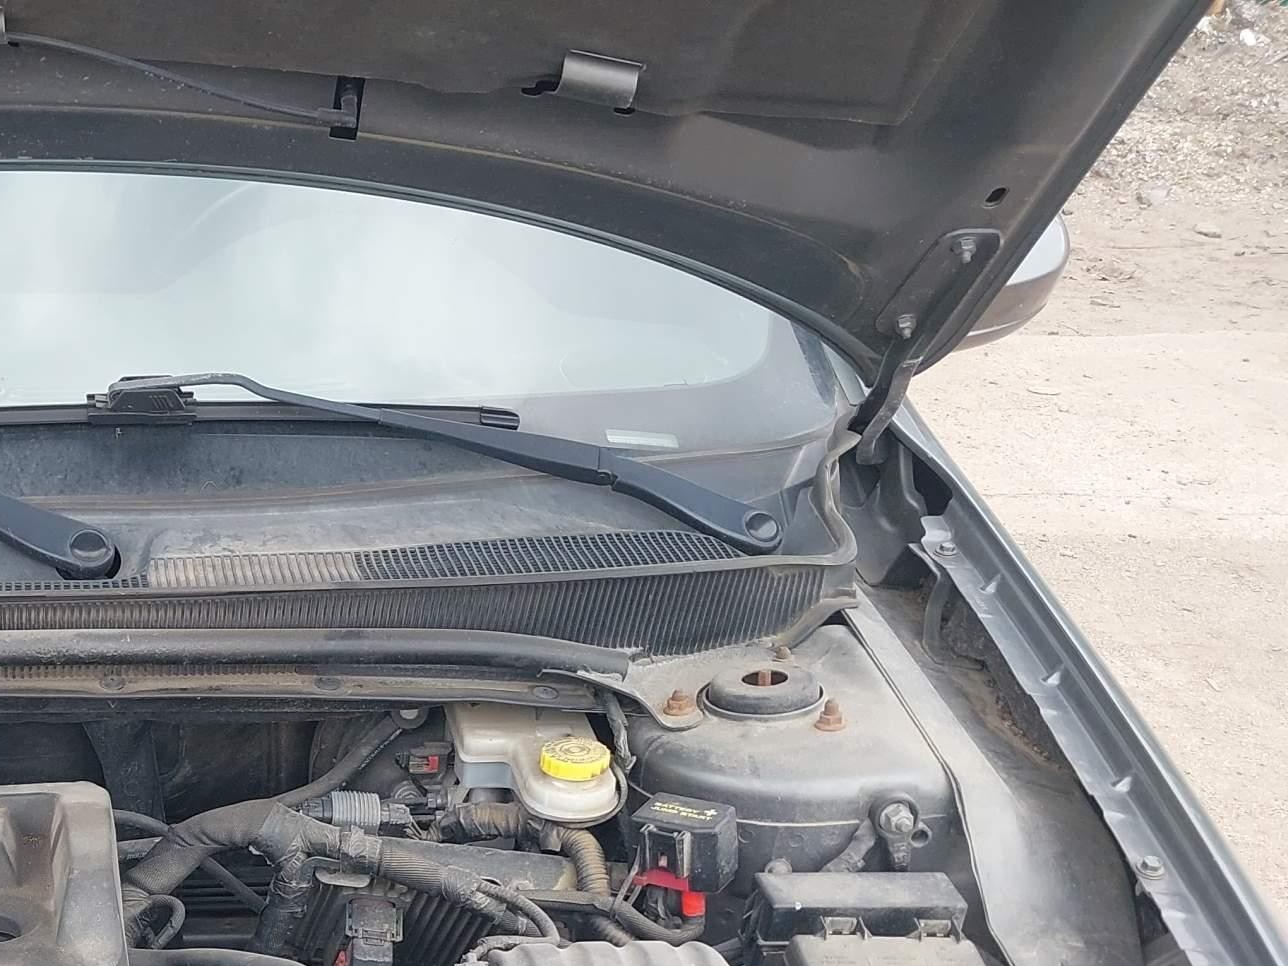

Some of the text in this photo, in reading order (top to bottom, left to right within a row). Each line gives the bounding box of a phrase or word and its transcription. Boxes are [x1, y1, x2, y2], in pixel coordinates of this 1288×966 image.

[650, 806, 713, 821] JUMP START
[654, 802, 701, 813] BATTERY
